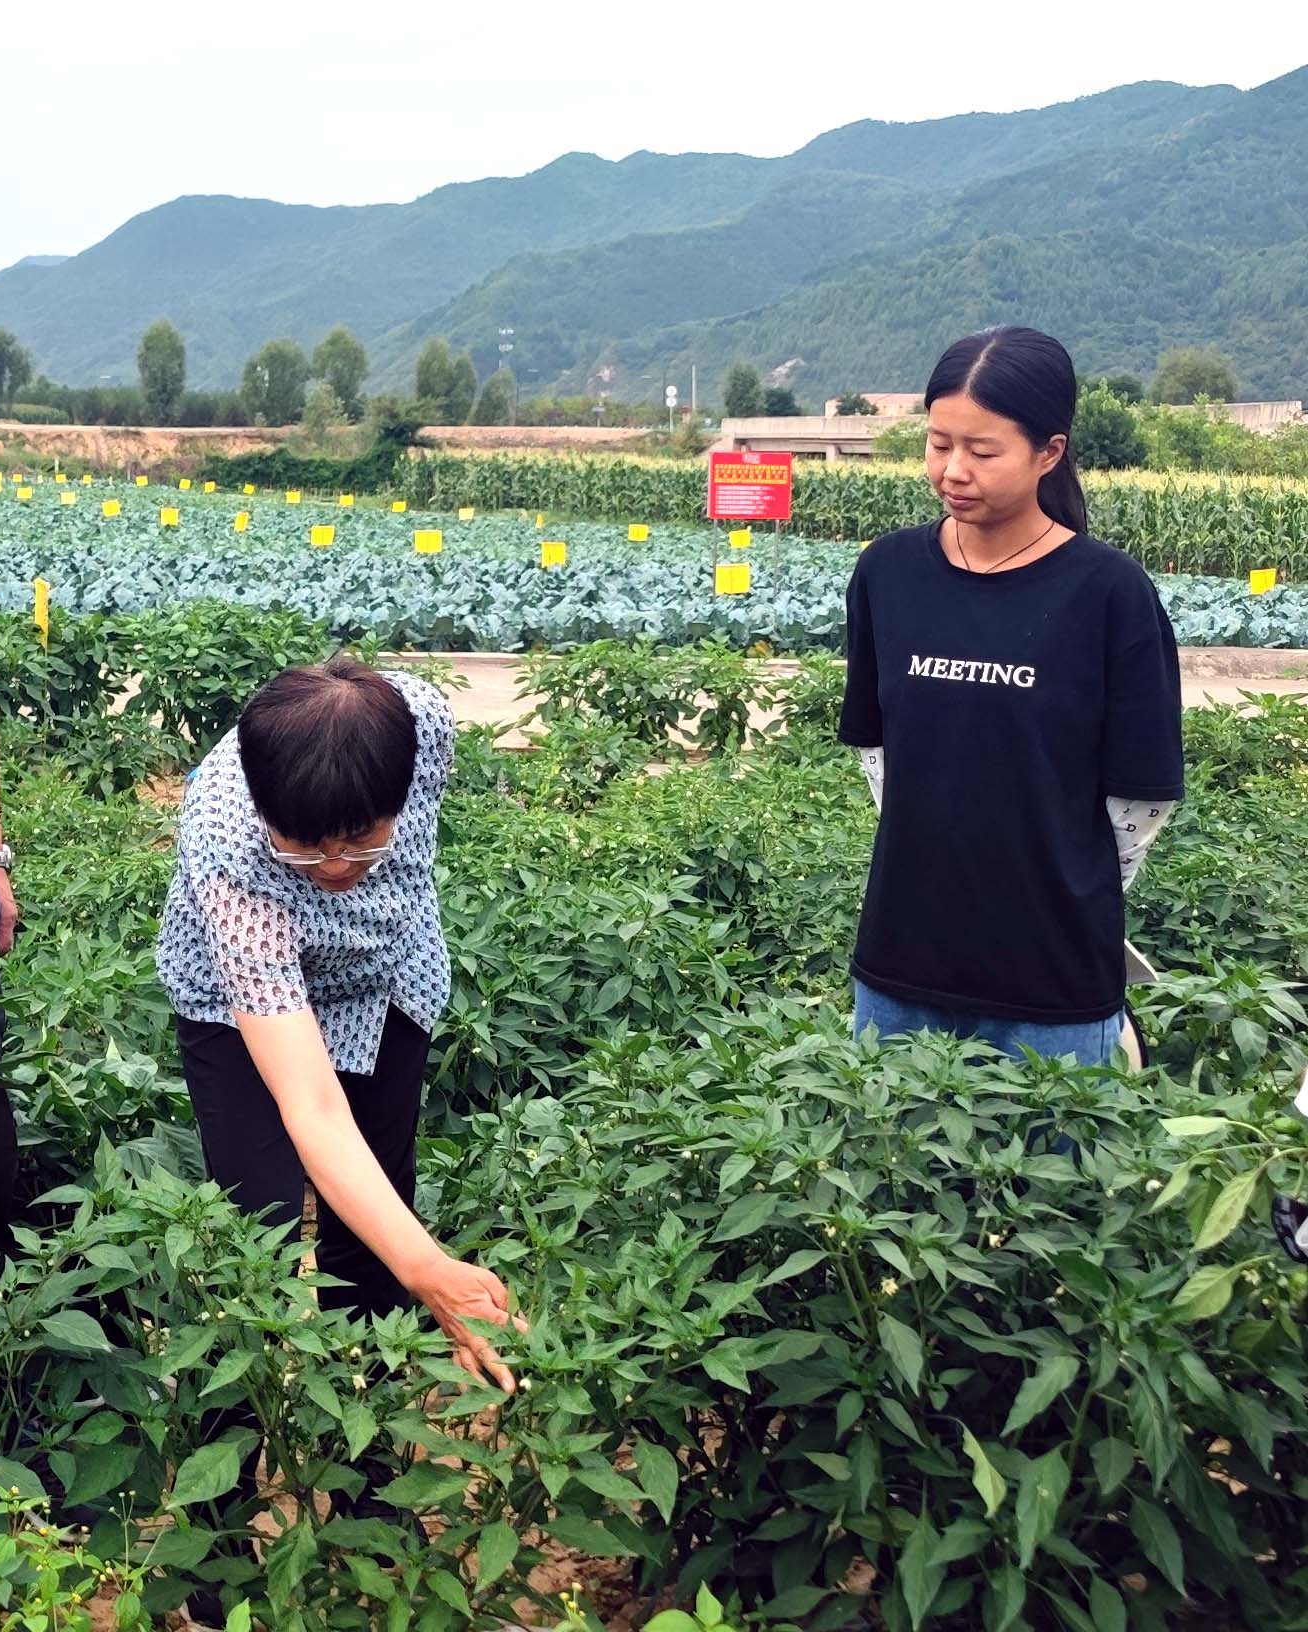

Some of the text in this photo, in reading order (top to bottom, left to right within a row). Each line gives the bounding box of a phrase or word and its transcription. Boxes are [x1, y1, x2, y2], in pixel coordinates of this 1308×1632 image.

[908, 655, 1035, 687] MEETING
[869, 756, 876, 764] D
[1148, 809, 1159, 817] D
[1125, 823, 1136, 832] D
